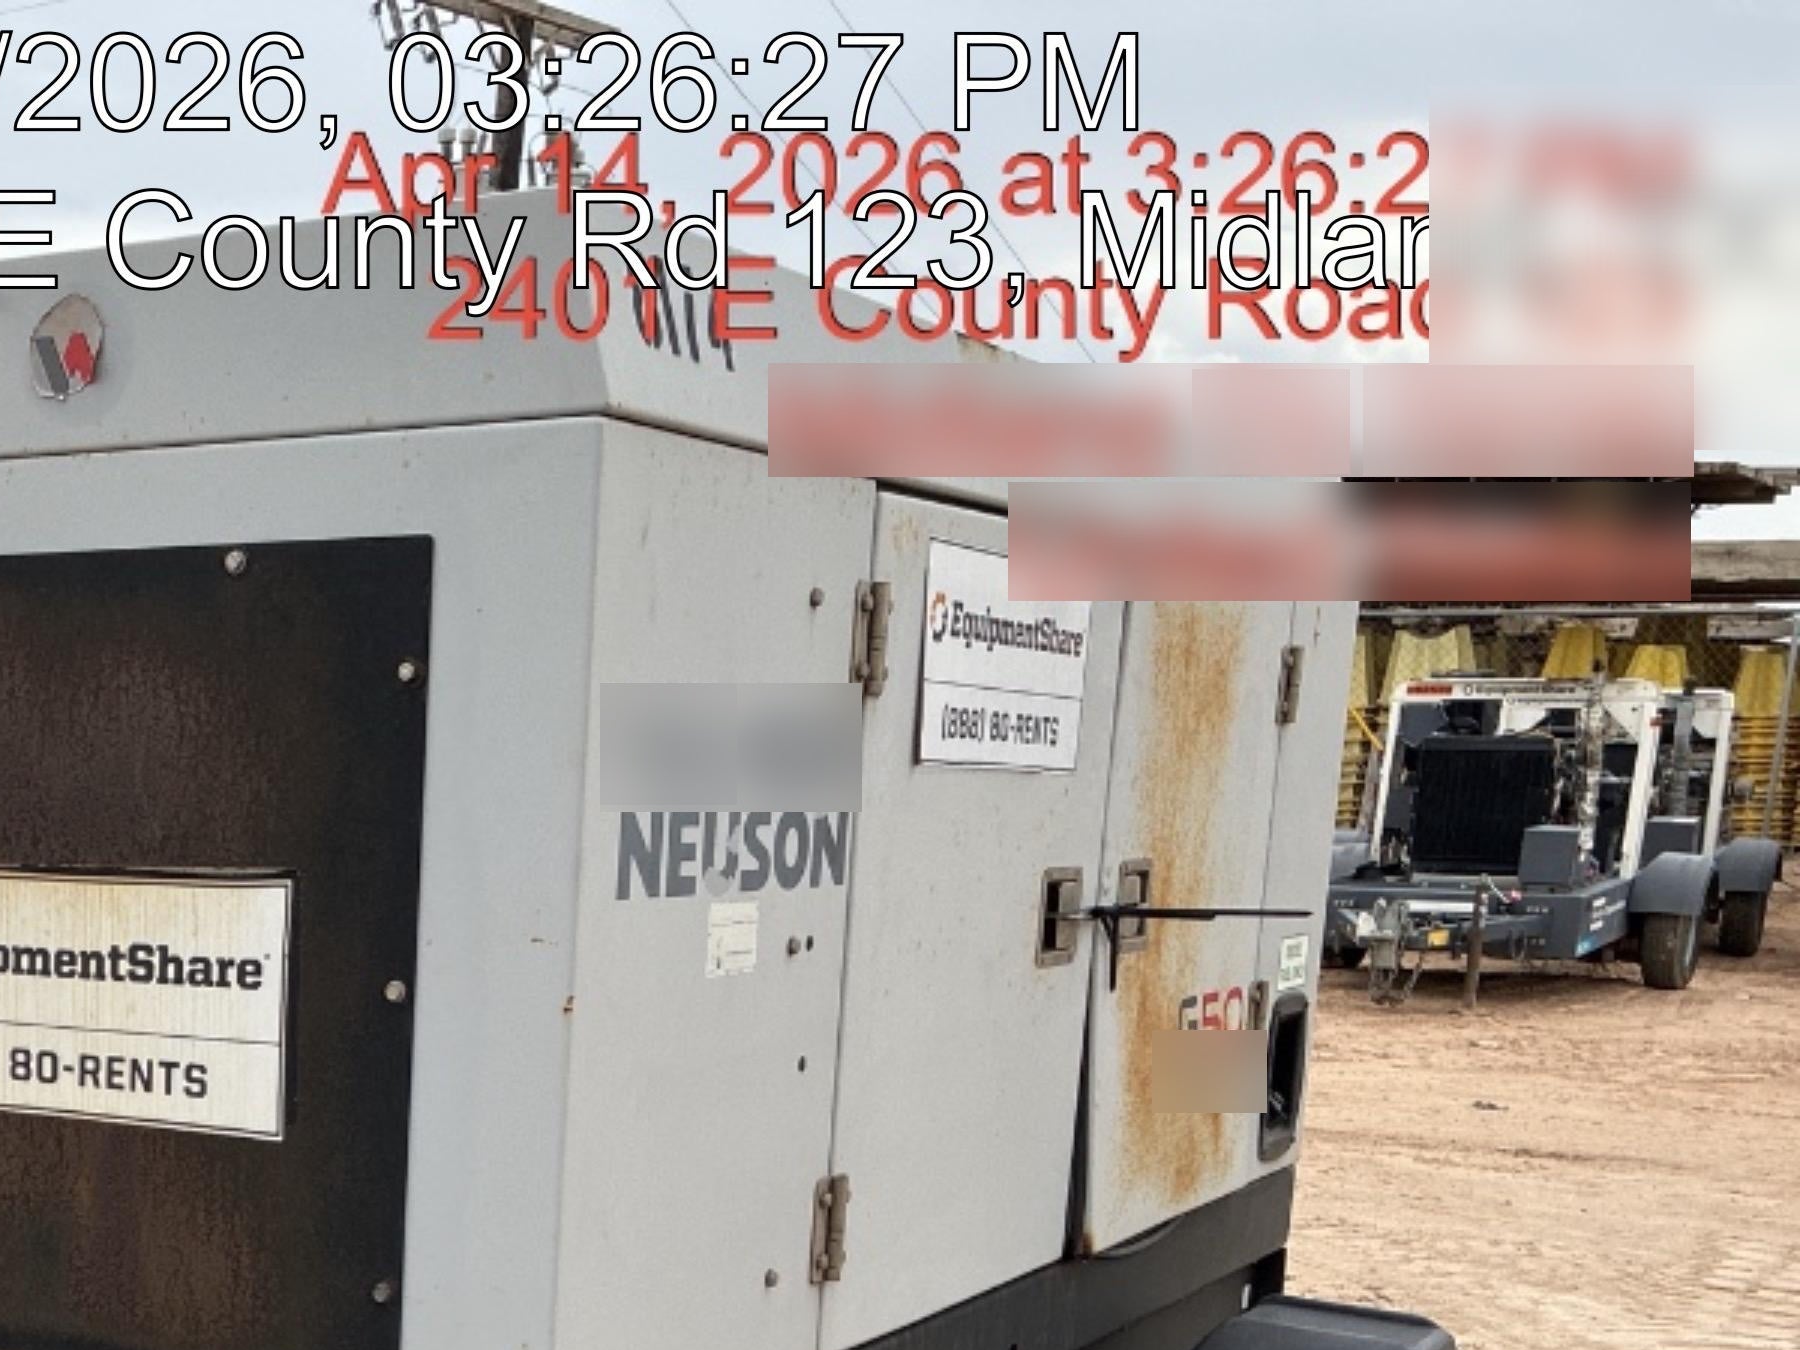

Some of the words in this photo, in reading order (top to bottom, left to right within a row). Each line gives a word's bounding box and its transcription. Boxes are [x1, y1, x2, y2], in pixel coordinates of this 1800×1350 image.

[950, 599, 1085, 658] EquipmentShare
[941, 703, 985, 743] (888)
[989, 708, 1060, 747] 80-RENTS
[615, 811, 850, 901] NEUSON
[10, 1046, 209, 1098] 80-RENTS
